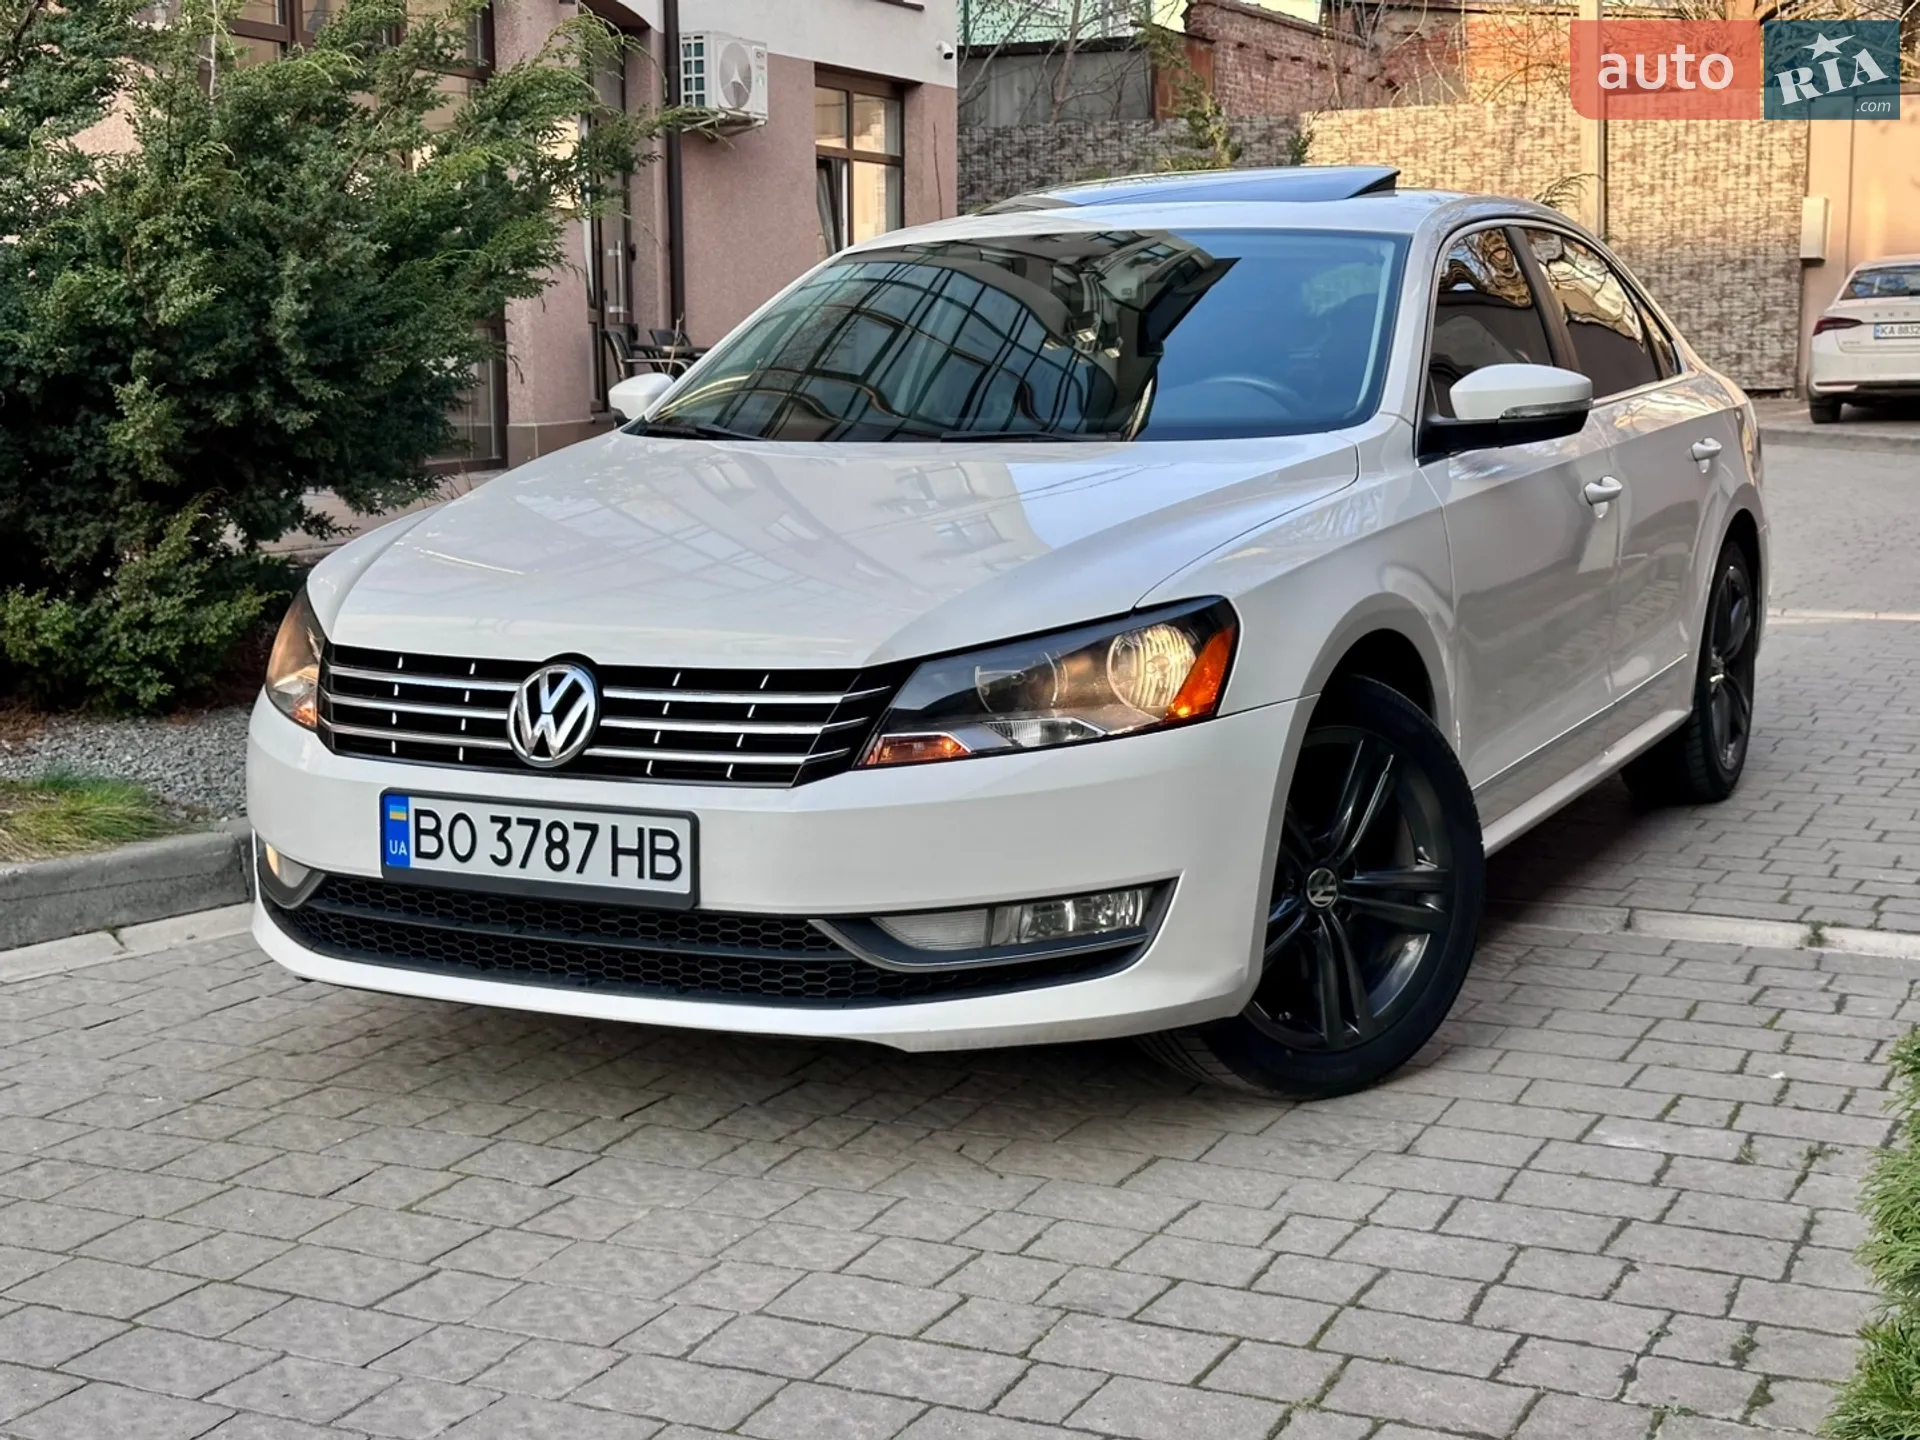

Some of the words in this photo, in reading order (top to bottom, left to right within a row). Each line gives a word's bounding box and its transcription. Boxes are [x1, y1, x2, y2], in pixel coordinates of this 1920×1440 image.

[389, 839, 408, 856] UA
[414, 808, 477, 863] BO
[489, 815, 599, 874] 3787
[611, 825, 682, 881] HB
